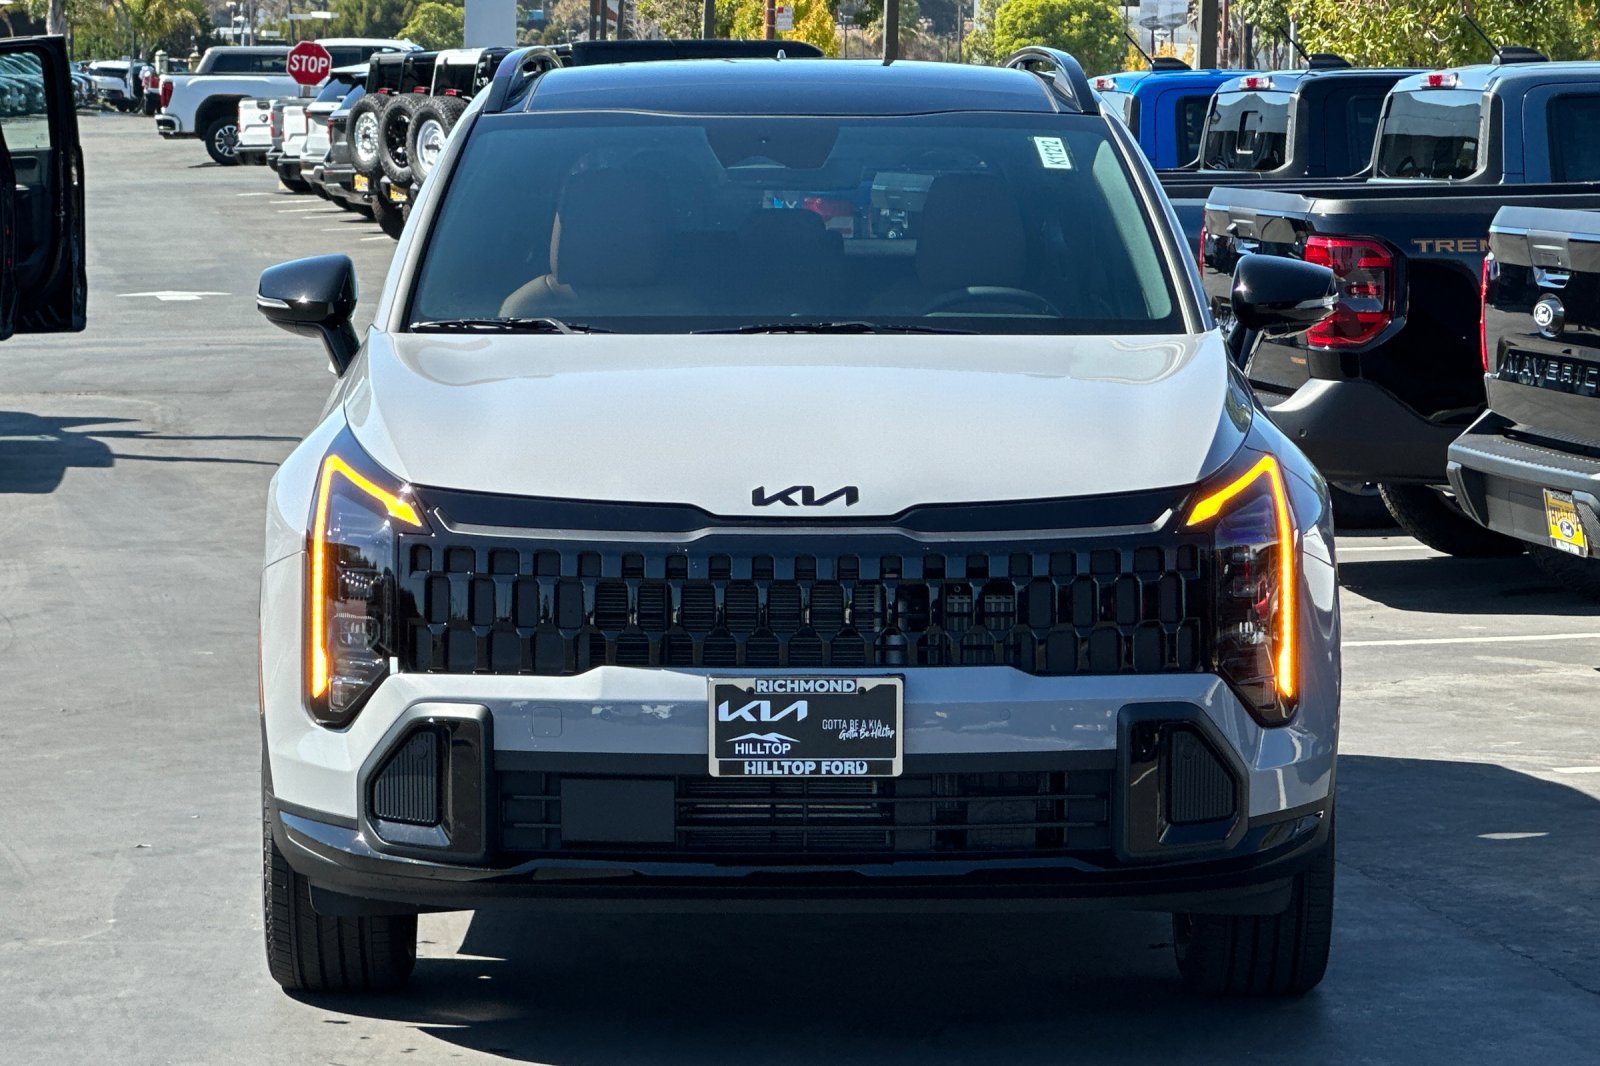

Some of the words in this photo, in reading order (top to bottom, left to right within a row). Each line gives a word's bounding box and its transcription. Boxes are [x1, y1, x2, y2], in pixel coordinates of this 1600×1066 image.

[290, 54, 329, 73] STOP
[1506, 353, 1600, 388] MAVERIC
[752, 485, 859, 507] KIA
[756, 679, 856, 693] RICHMOND
[718, 700, 808, 722] KIA
[822, 719, 847, 730] GOTTA
[849, 719, 859, 730] BE
[861, 719, 867, 730] A
[869, 719, 882, 730] KIA
[838, 727, 858, 740] Gotta
[859, 728, 870, 739] Be
[871, 724, 895, 739] Hilltop
[735, 743, 791, 754] HILLTOP
[744, 761, 816, 775] HILLTOP
[821, 761, 868, 775] FORD
